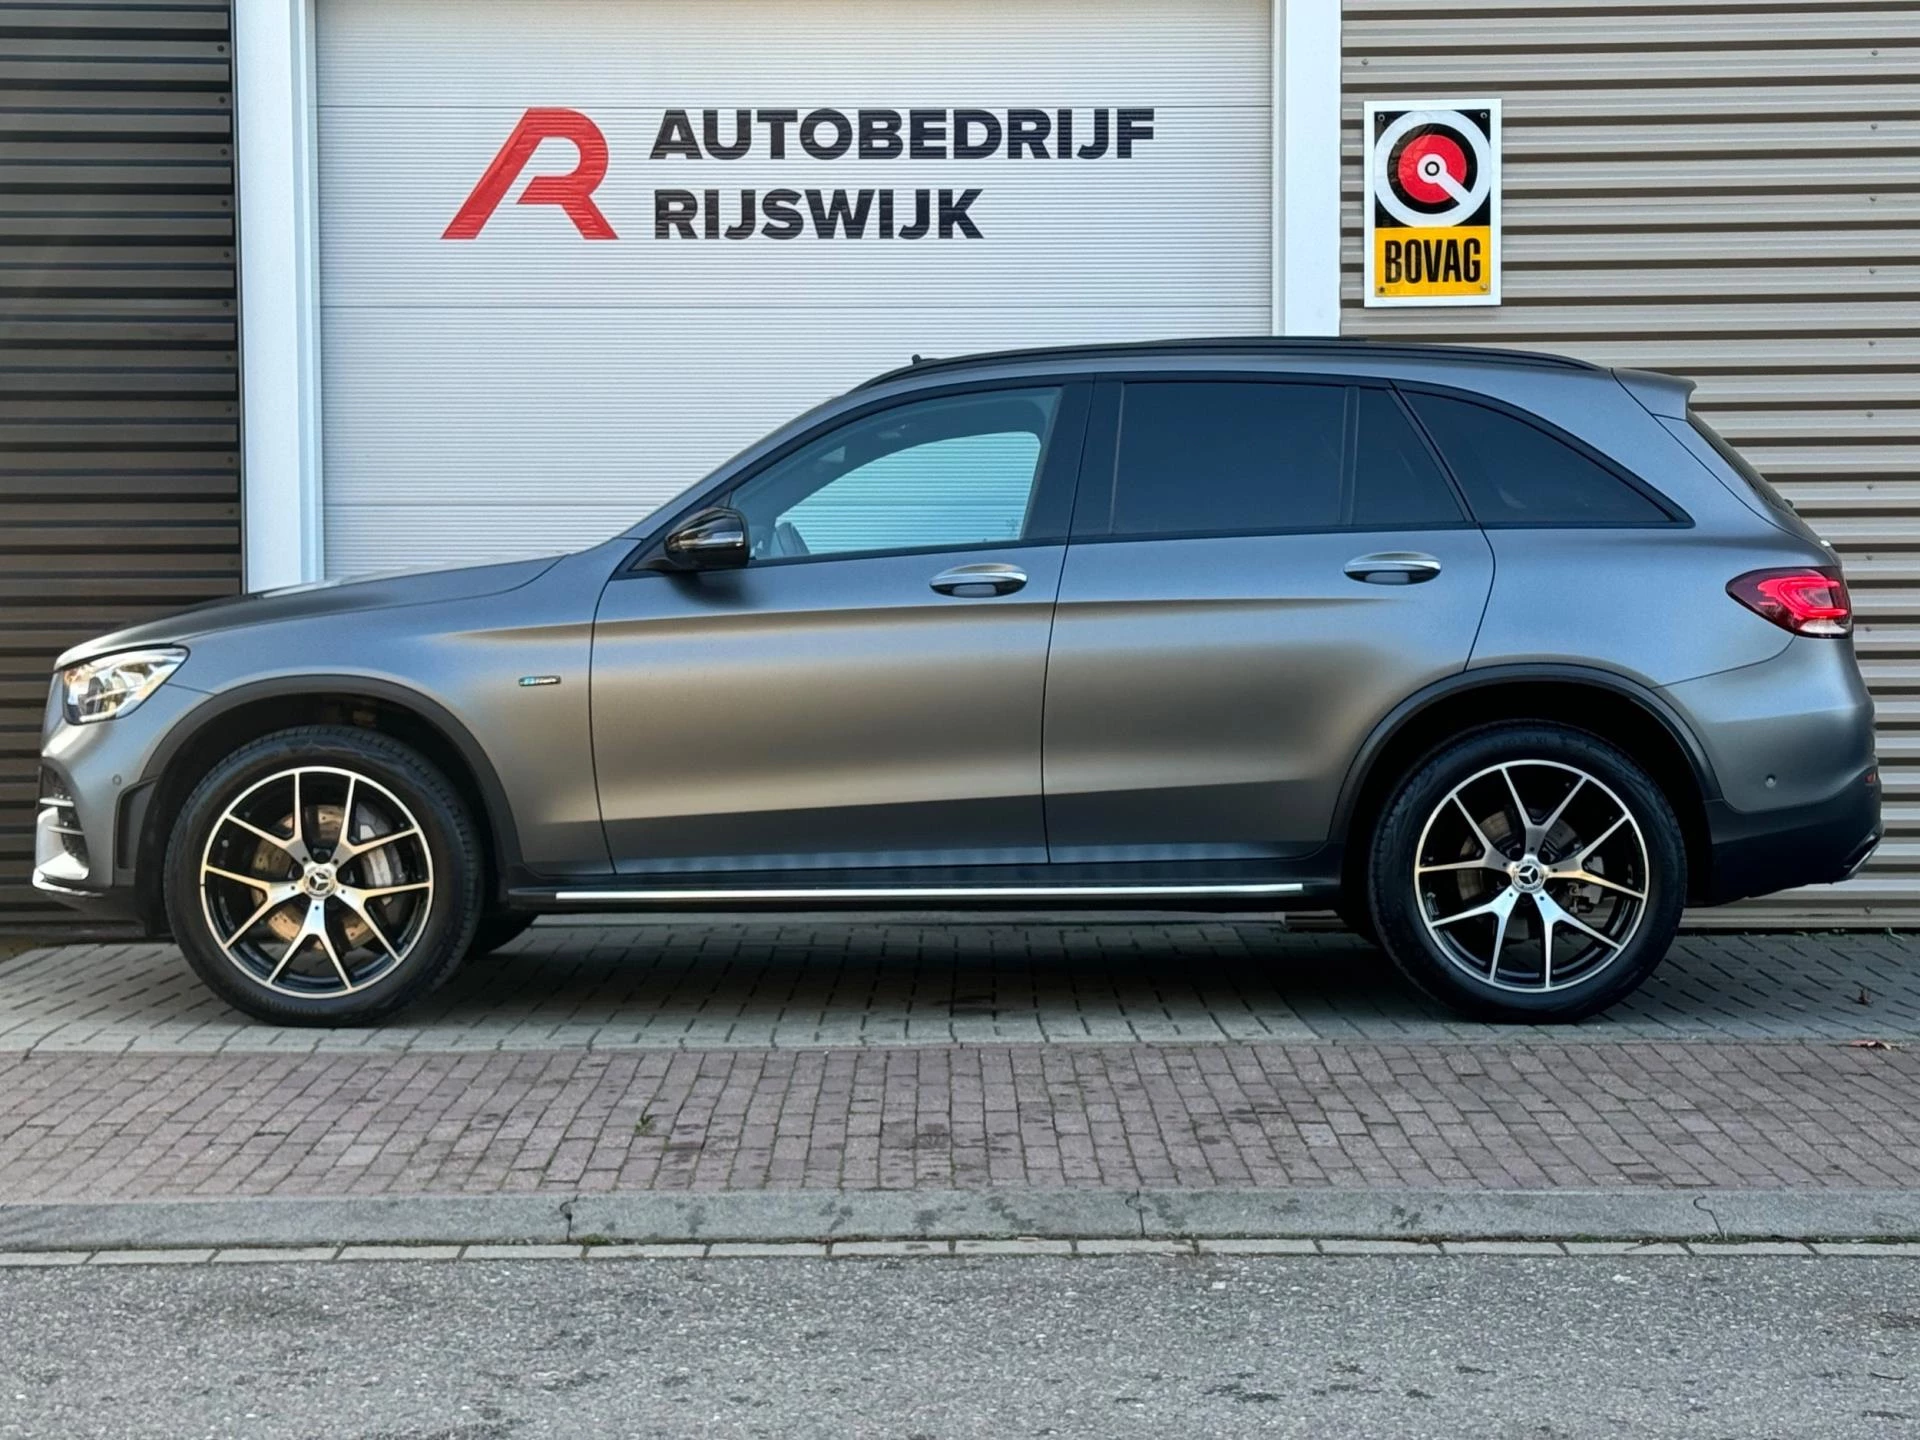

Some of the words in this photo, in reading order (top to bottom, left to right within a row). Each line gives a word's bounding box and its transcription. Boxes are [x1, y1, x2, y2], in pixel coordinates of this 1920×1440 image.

[650, 108, 1155, 160] AUTOBEDRIJF
[654, 188, 984, 240] RIJSWIJK
[1384, 237, 1481, 284] BOVAG
